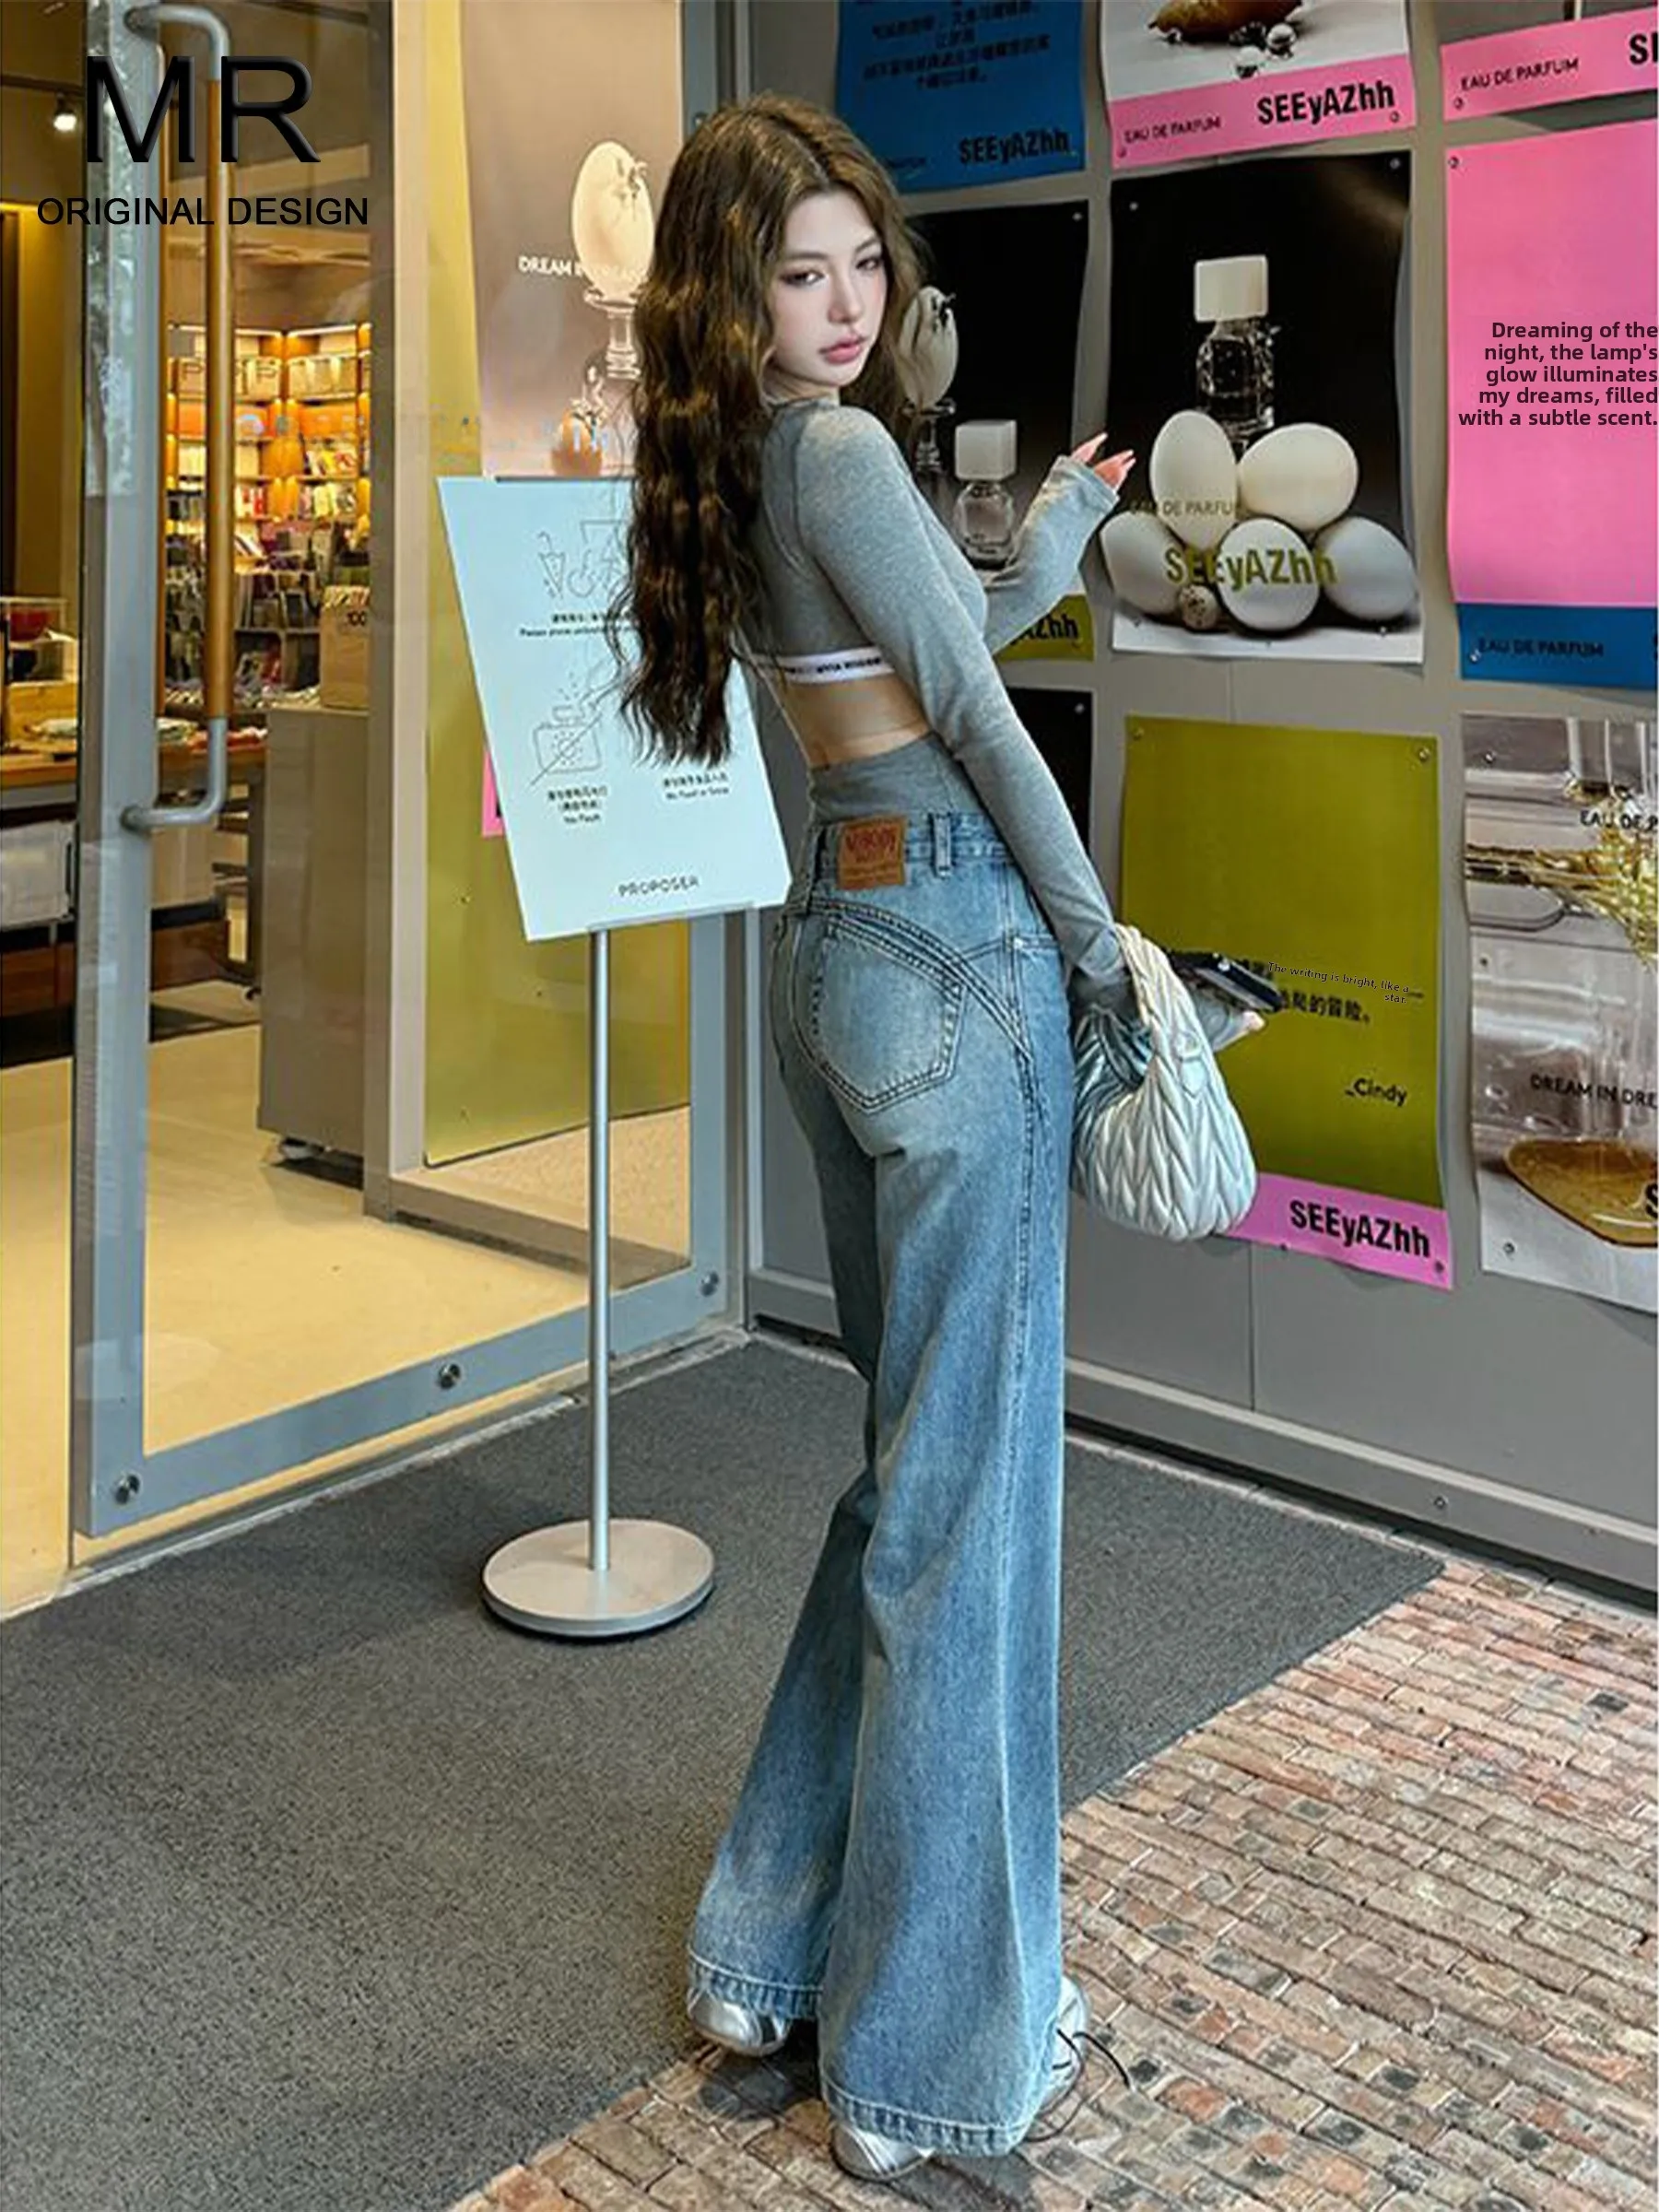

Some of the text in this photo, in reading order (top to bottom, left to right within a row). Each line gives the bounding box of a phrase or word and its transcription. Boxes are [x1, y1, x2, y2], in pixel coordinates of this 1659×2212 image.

[1460, 58, 1580, 90] EAU DE PARFUM
[1256, 81, 1395, 125] SEEyAZhh
[959, 129, 1070, 165] SEEyAZhh
[1165, 547, 1340, 591] SEEyAZhh
[1530, 1074, 1593, 1098] DREAM
[1289, 1199, 1430, 1258] SEEyAZhh
